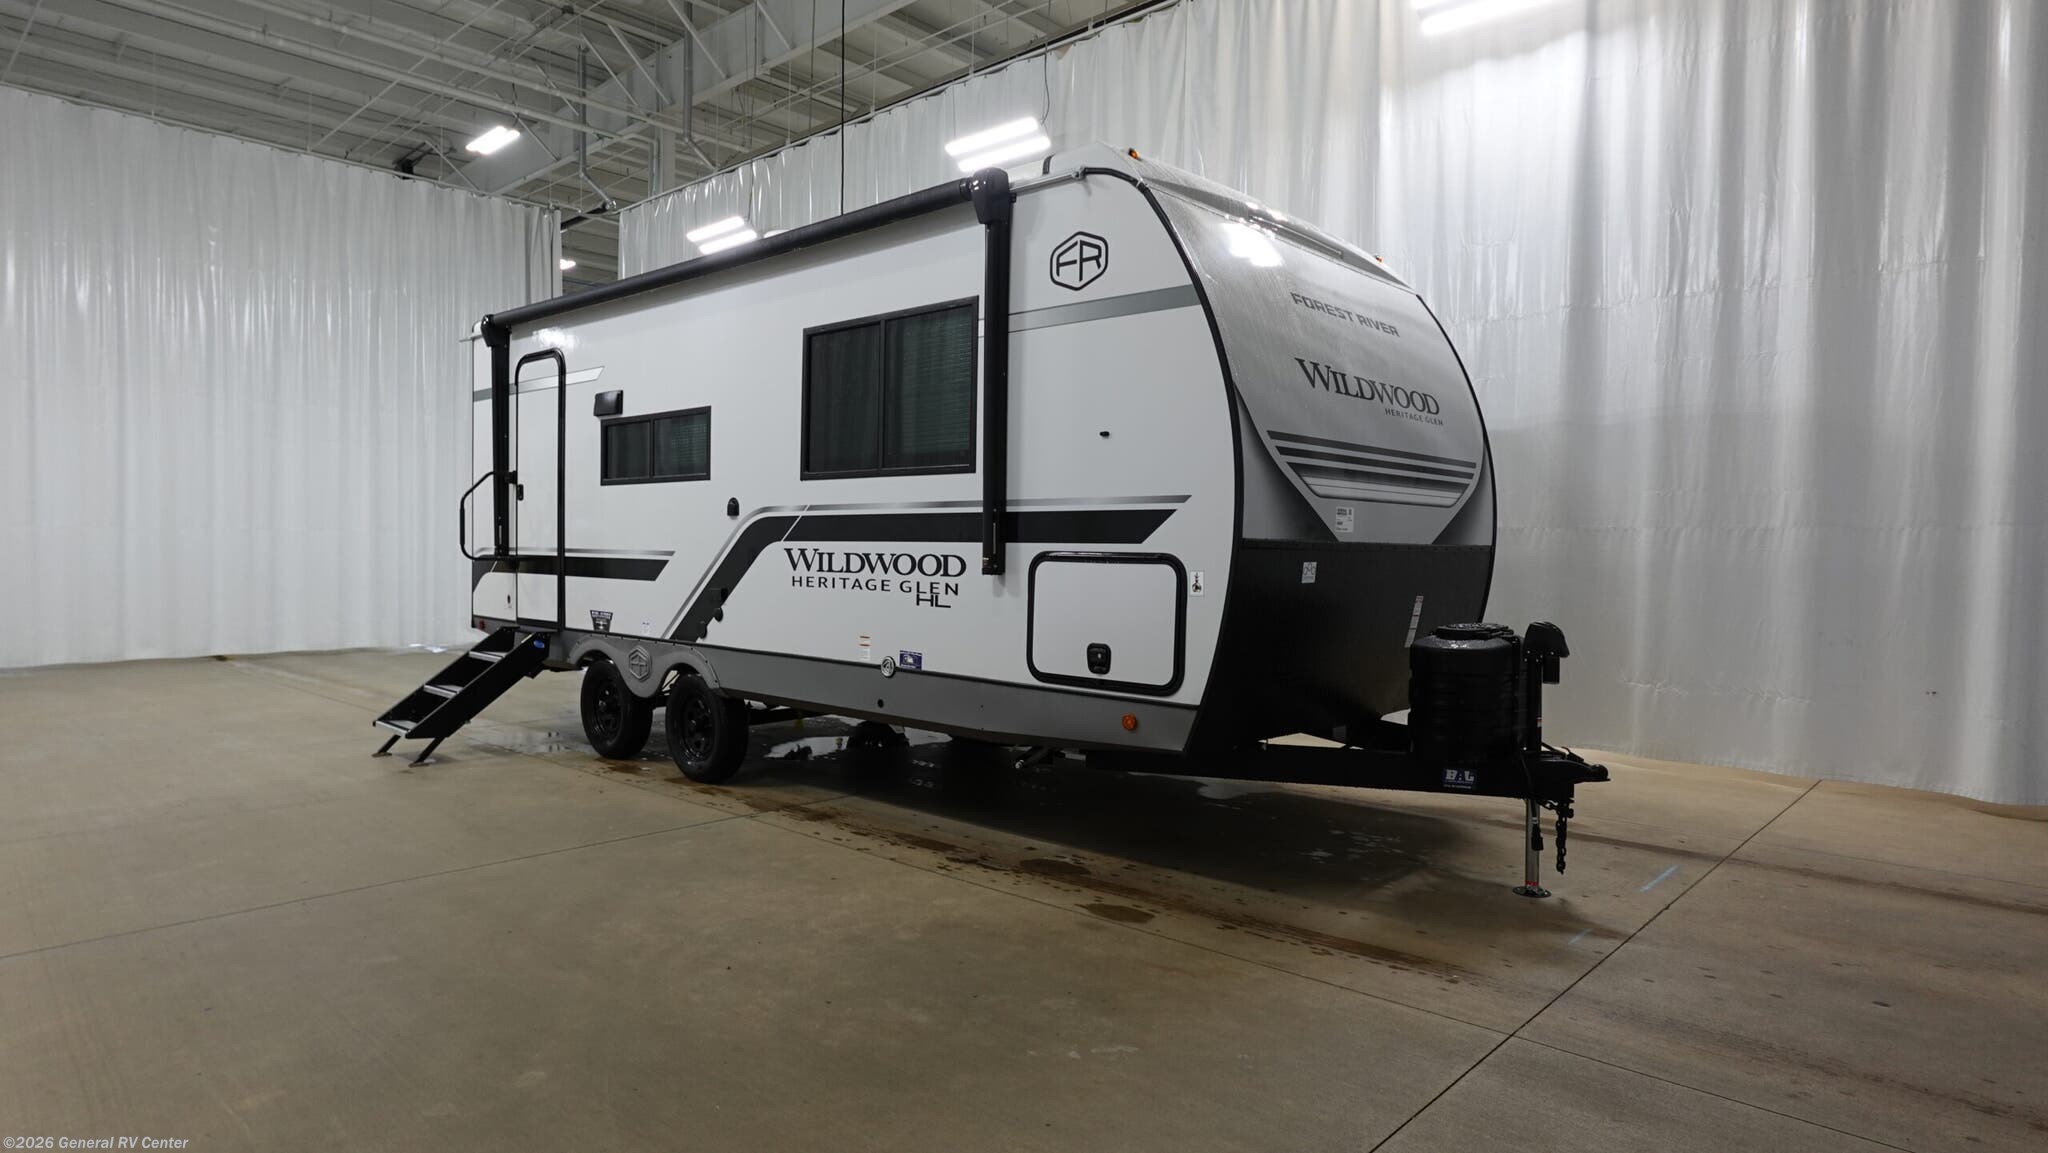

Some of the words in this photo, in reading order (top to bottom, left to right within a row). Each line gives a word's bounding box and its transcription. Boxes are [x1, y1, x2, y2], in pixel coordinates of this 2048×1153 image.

[1055, 239, 1103, 283] FR
[1290, 291, 1353, 322] FOREST
[1357, 314, 1401, 338] RIVER
[1294, 357, 1440, 416] WILDWOOD
[1384, 407, 1423, 423] HERITAGE
[1425, 416, 1444, 427] GLEN
[783, 547, 967, 578] WILDWOOD
[791, 575, 891, 592] HERITAGE
[899, 580, 959, 596] GLEN
[915, 592, 951, 609] HL
